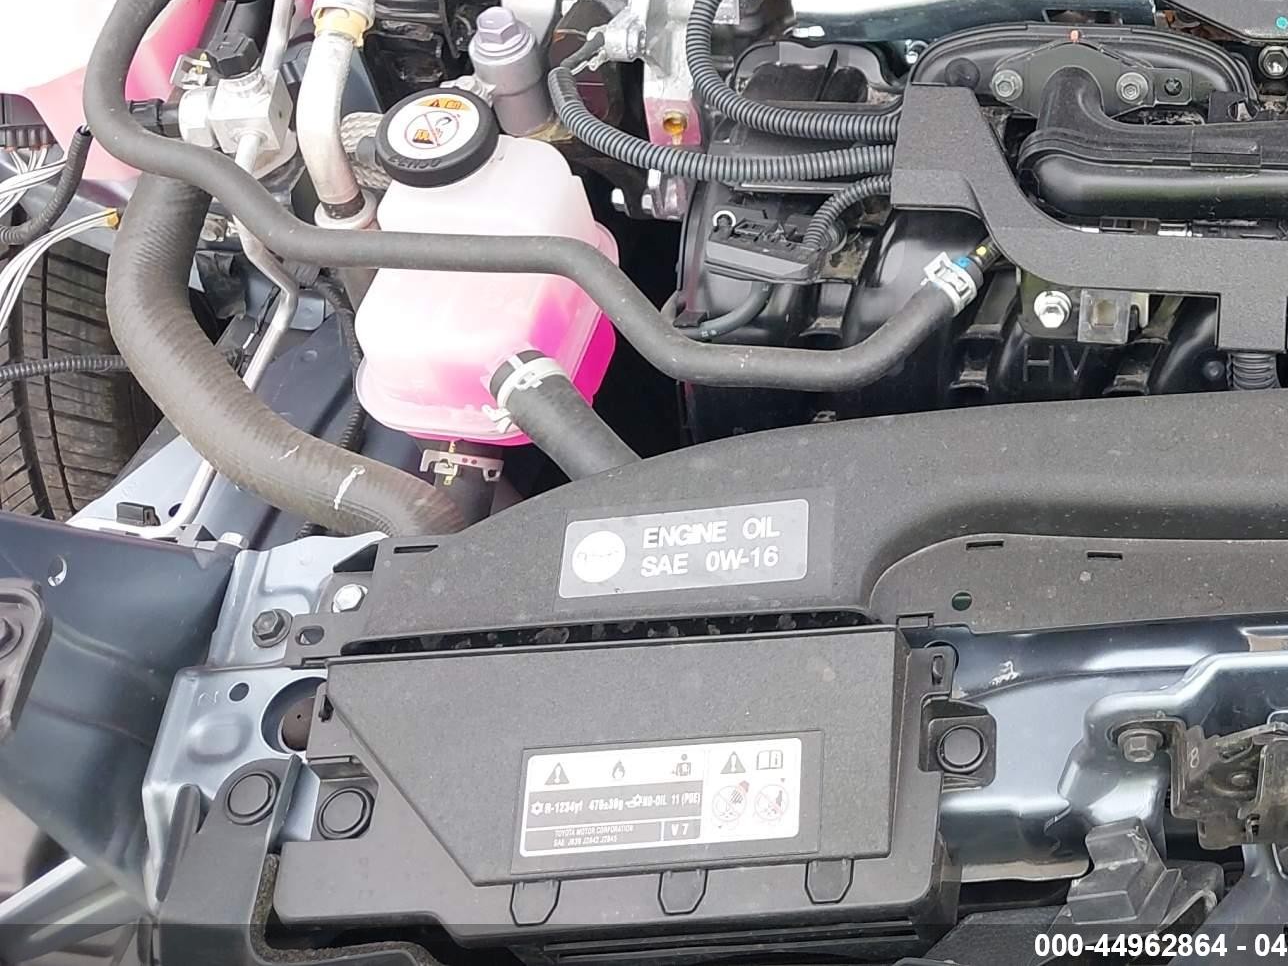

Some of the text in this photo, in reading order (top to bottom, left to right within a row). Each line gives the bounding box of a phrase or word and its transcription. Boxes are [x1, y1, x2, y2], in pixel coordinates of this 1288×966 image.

[643, 517, 780, 549] ENGINE OIL
[640, 552, 688, 577] SAE
[705, 545, 779, 572] 0W-16
[555, 824, 634, 837] TOYOTA MOTOR CORPORATION
[671, 823, 689, 836] V 7
